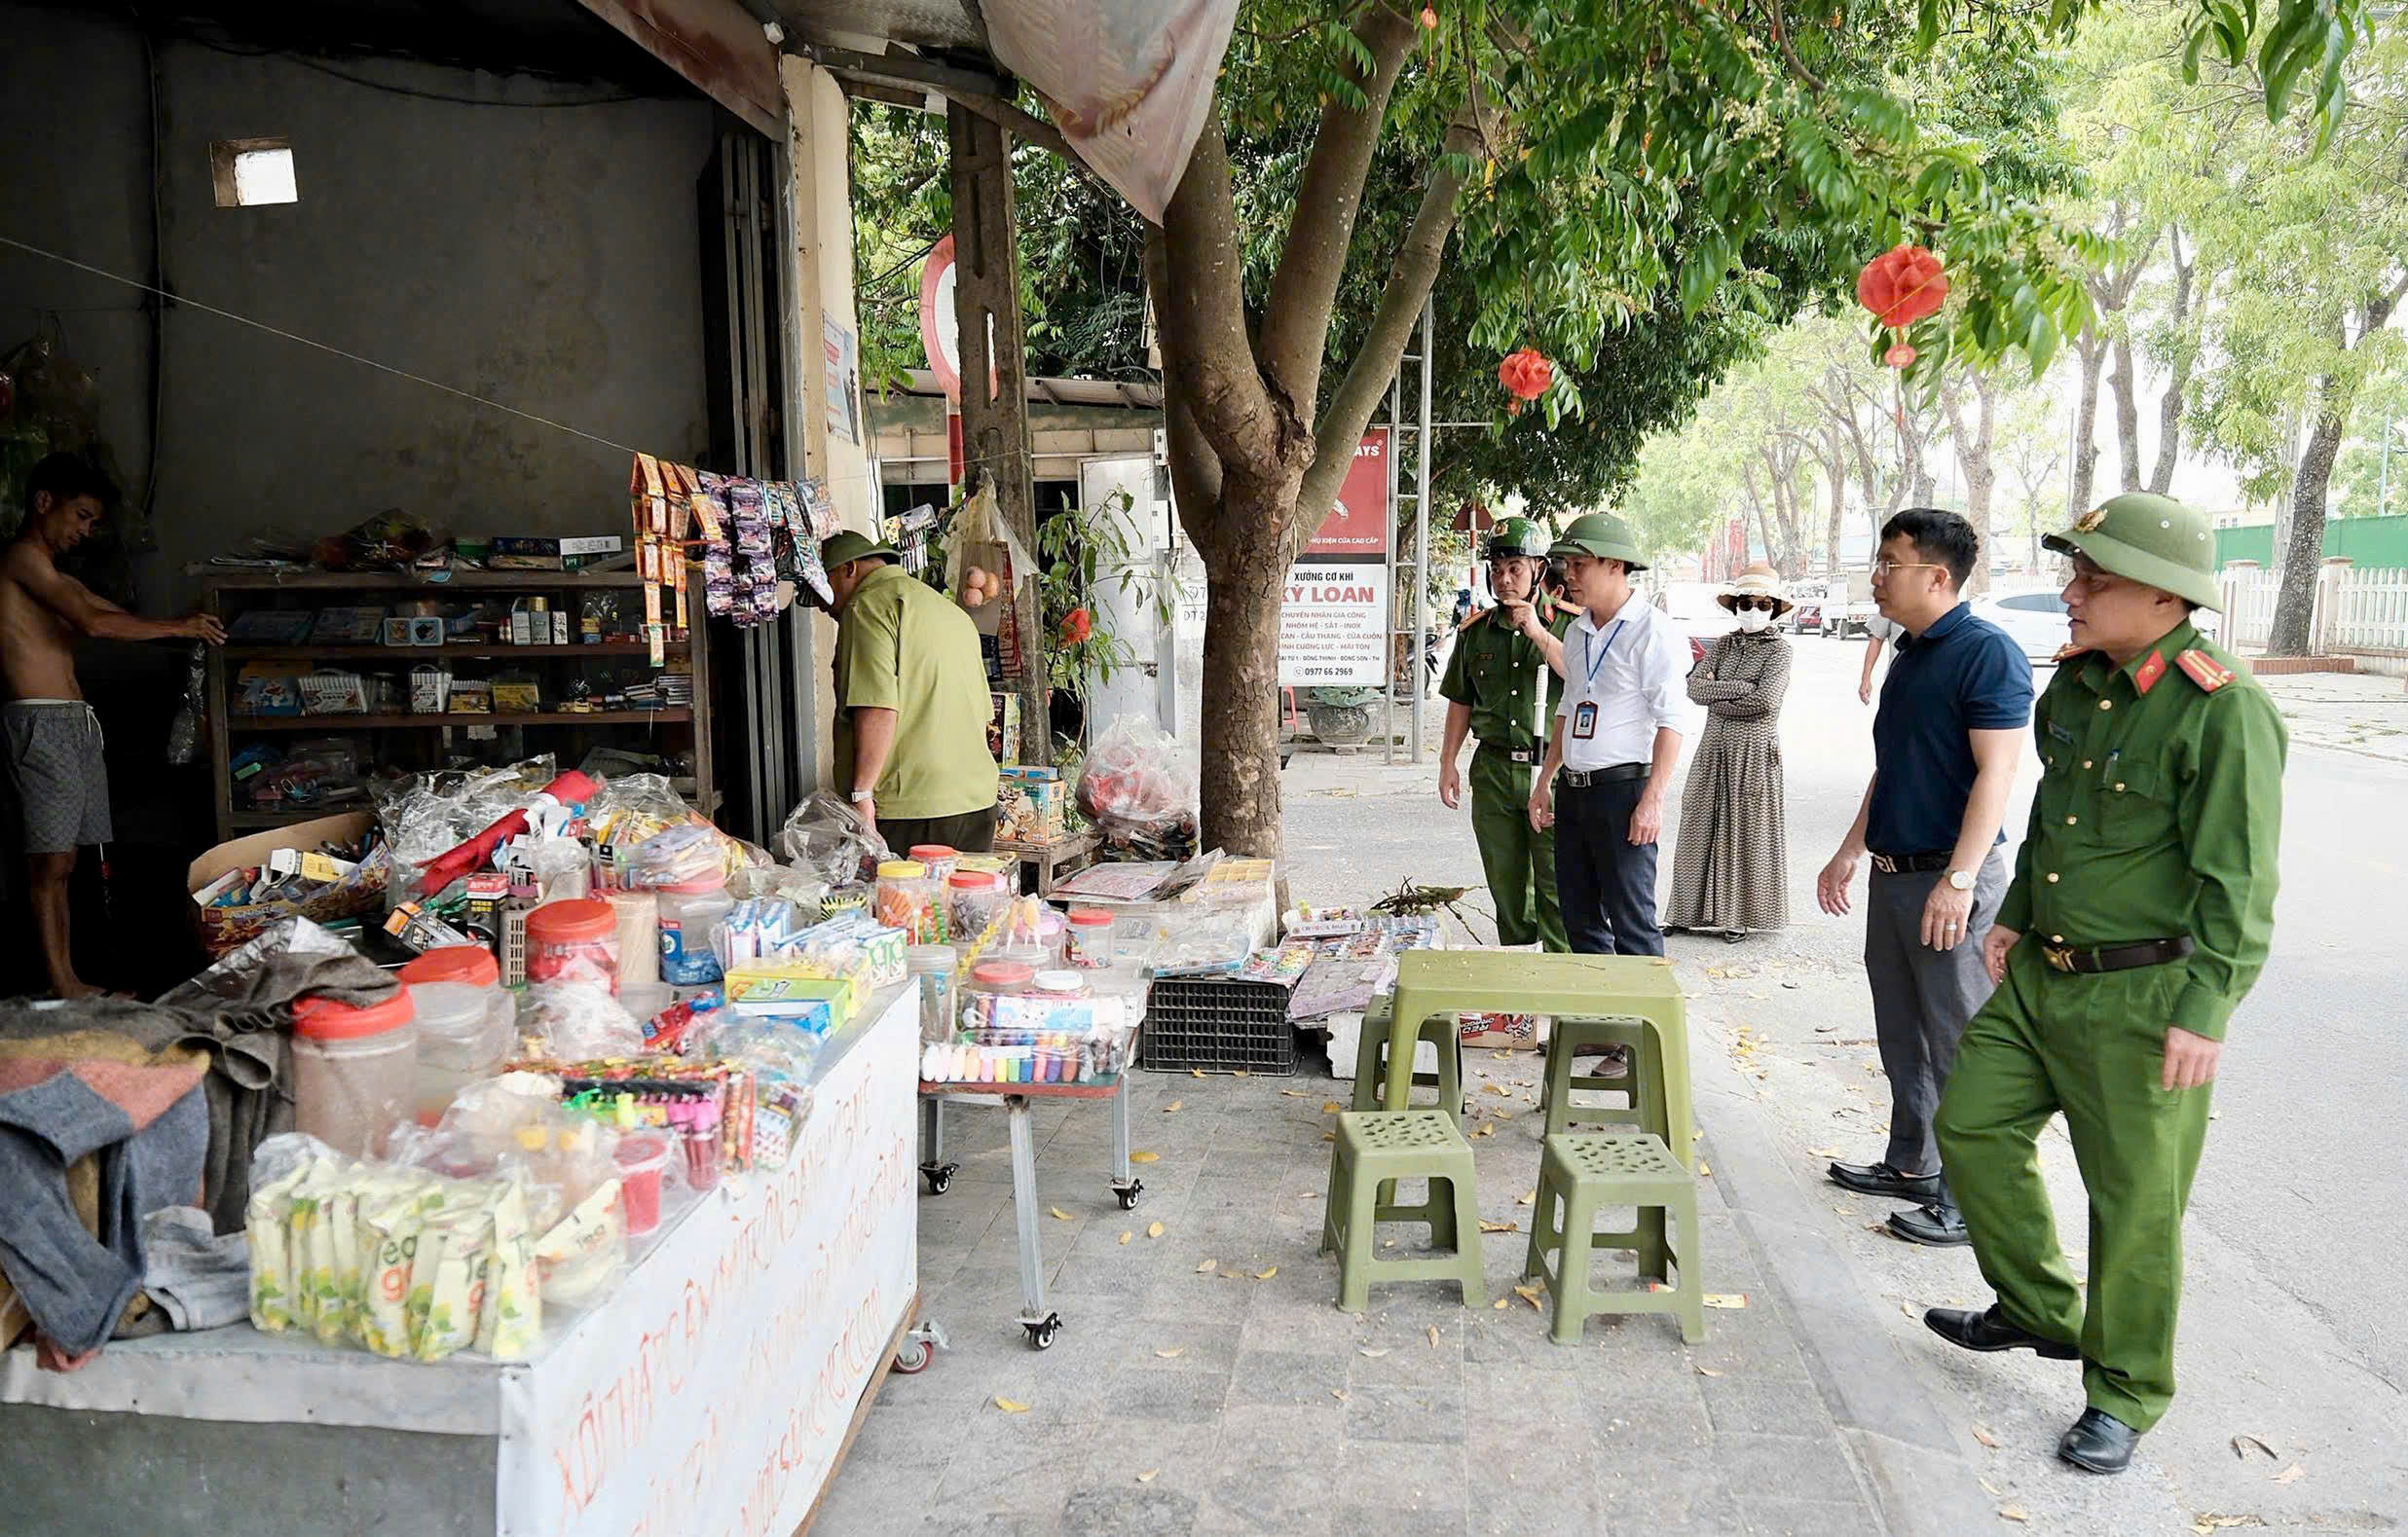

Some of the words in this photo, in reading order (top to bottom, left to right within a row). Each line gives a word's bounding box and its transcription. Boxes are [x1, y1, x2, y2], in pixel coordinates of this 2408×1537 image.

[1354, 445, 1380, 457] AYS
[1294, 569, 1322, 581] XƯỞNG
[1325, 571, 1337, 581] CƠ
[1339, 570, 1353, 581] KHÍ
[1311, 586, 1374, 603] LOAN
[1305, 667, 1322, 676] 0977
[1323, 667, 1333, 676] 66
